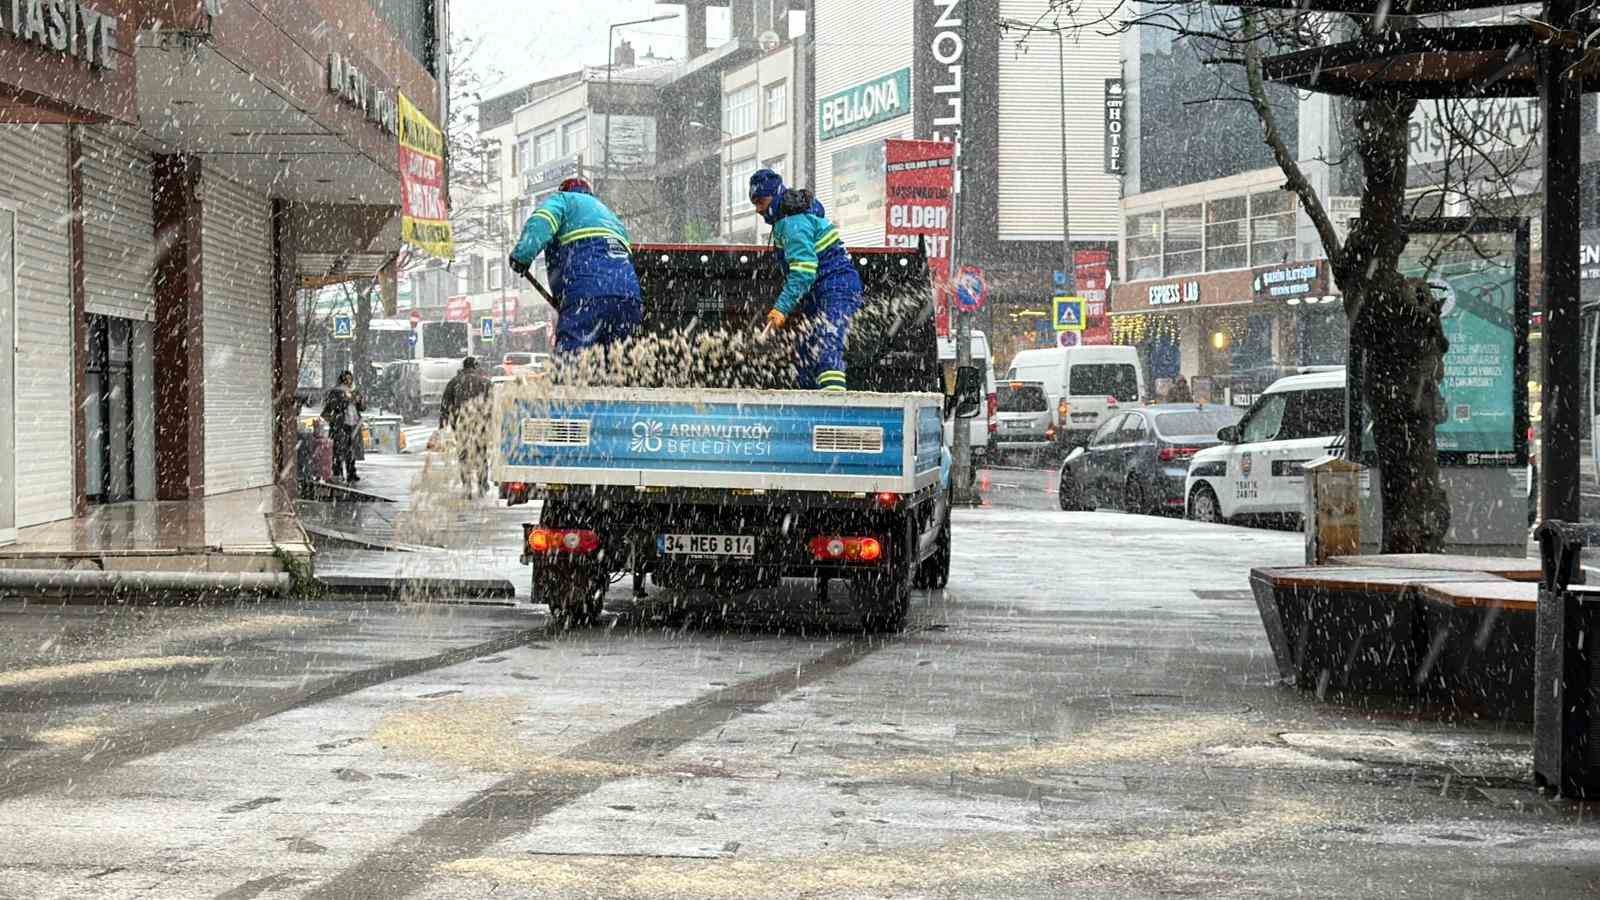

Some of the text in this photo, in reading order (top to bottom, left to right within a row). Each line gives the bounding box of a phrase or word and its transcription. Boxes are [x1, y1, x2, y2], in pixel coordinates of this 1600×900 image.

[823, 78, 900, 132] BELLONA
[1109, 108, 1121, 170] HOTEL
[670, 423, 772, 439] ARNAVUTKÖY
[668, 439, 771, 456] BELEDİYESİ
[666, 535, 752, 554] 34 MEG 814
